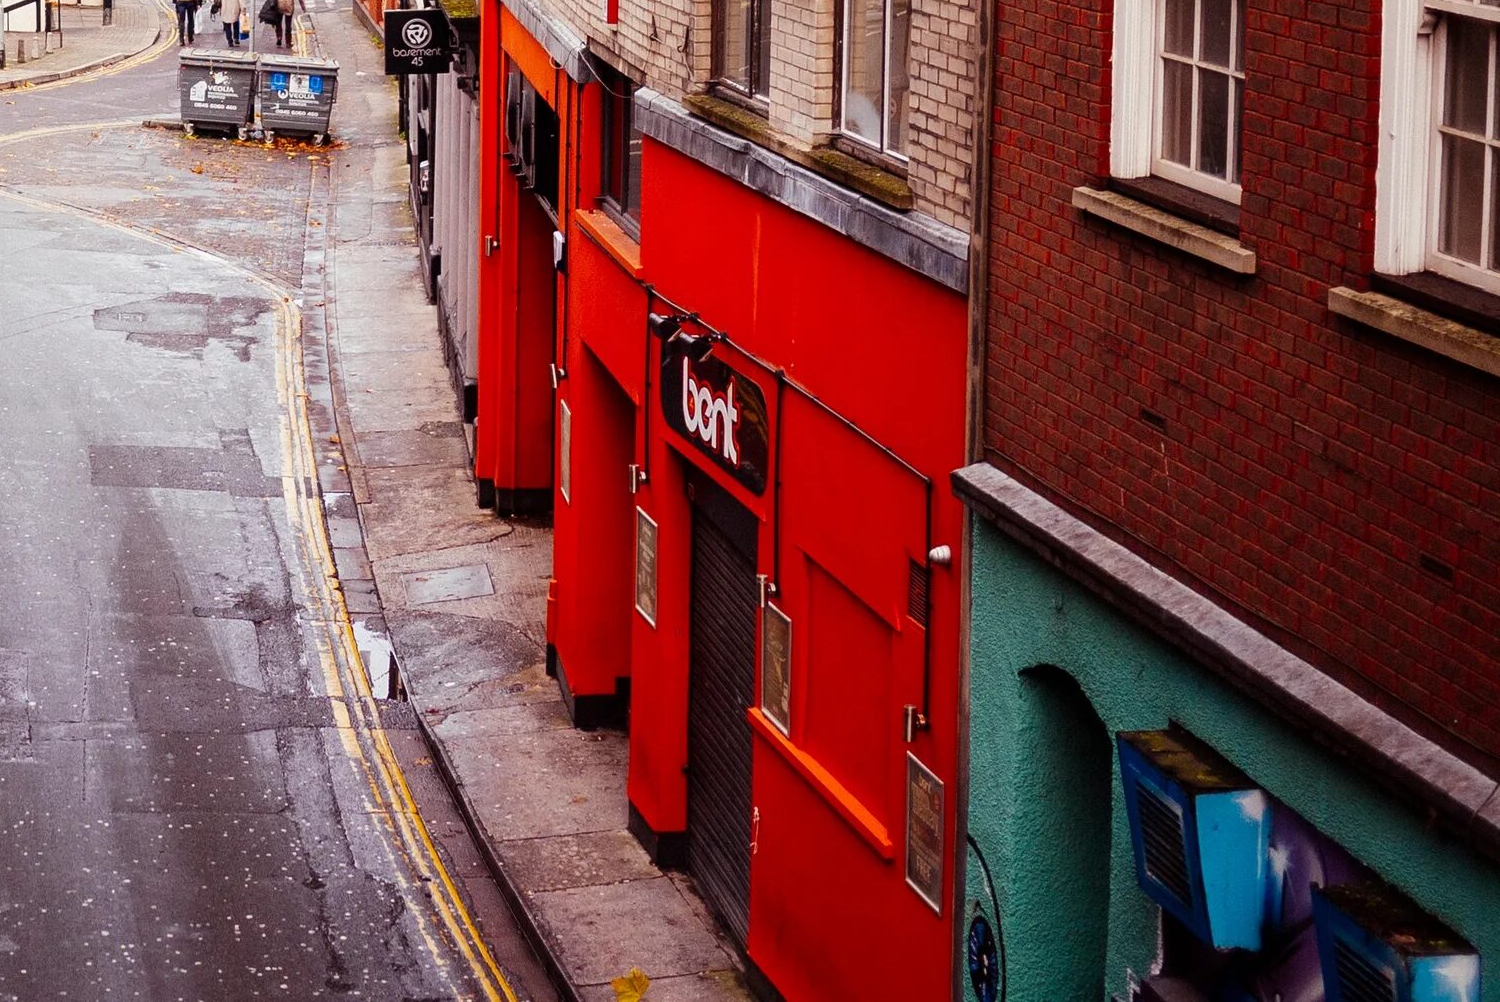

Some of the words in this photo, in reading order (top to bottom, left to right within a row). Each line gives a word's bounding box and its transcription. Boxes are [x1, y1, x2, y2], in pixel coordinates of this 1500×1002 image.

[392, 48, 441, 57] basement
[411, 57, 424, 66] 45
[207, 85, 235, 93] VEOLIA
[289, 92, 316, 100] VEOLIA
[682, 355, 738, 465] bent
